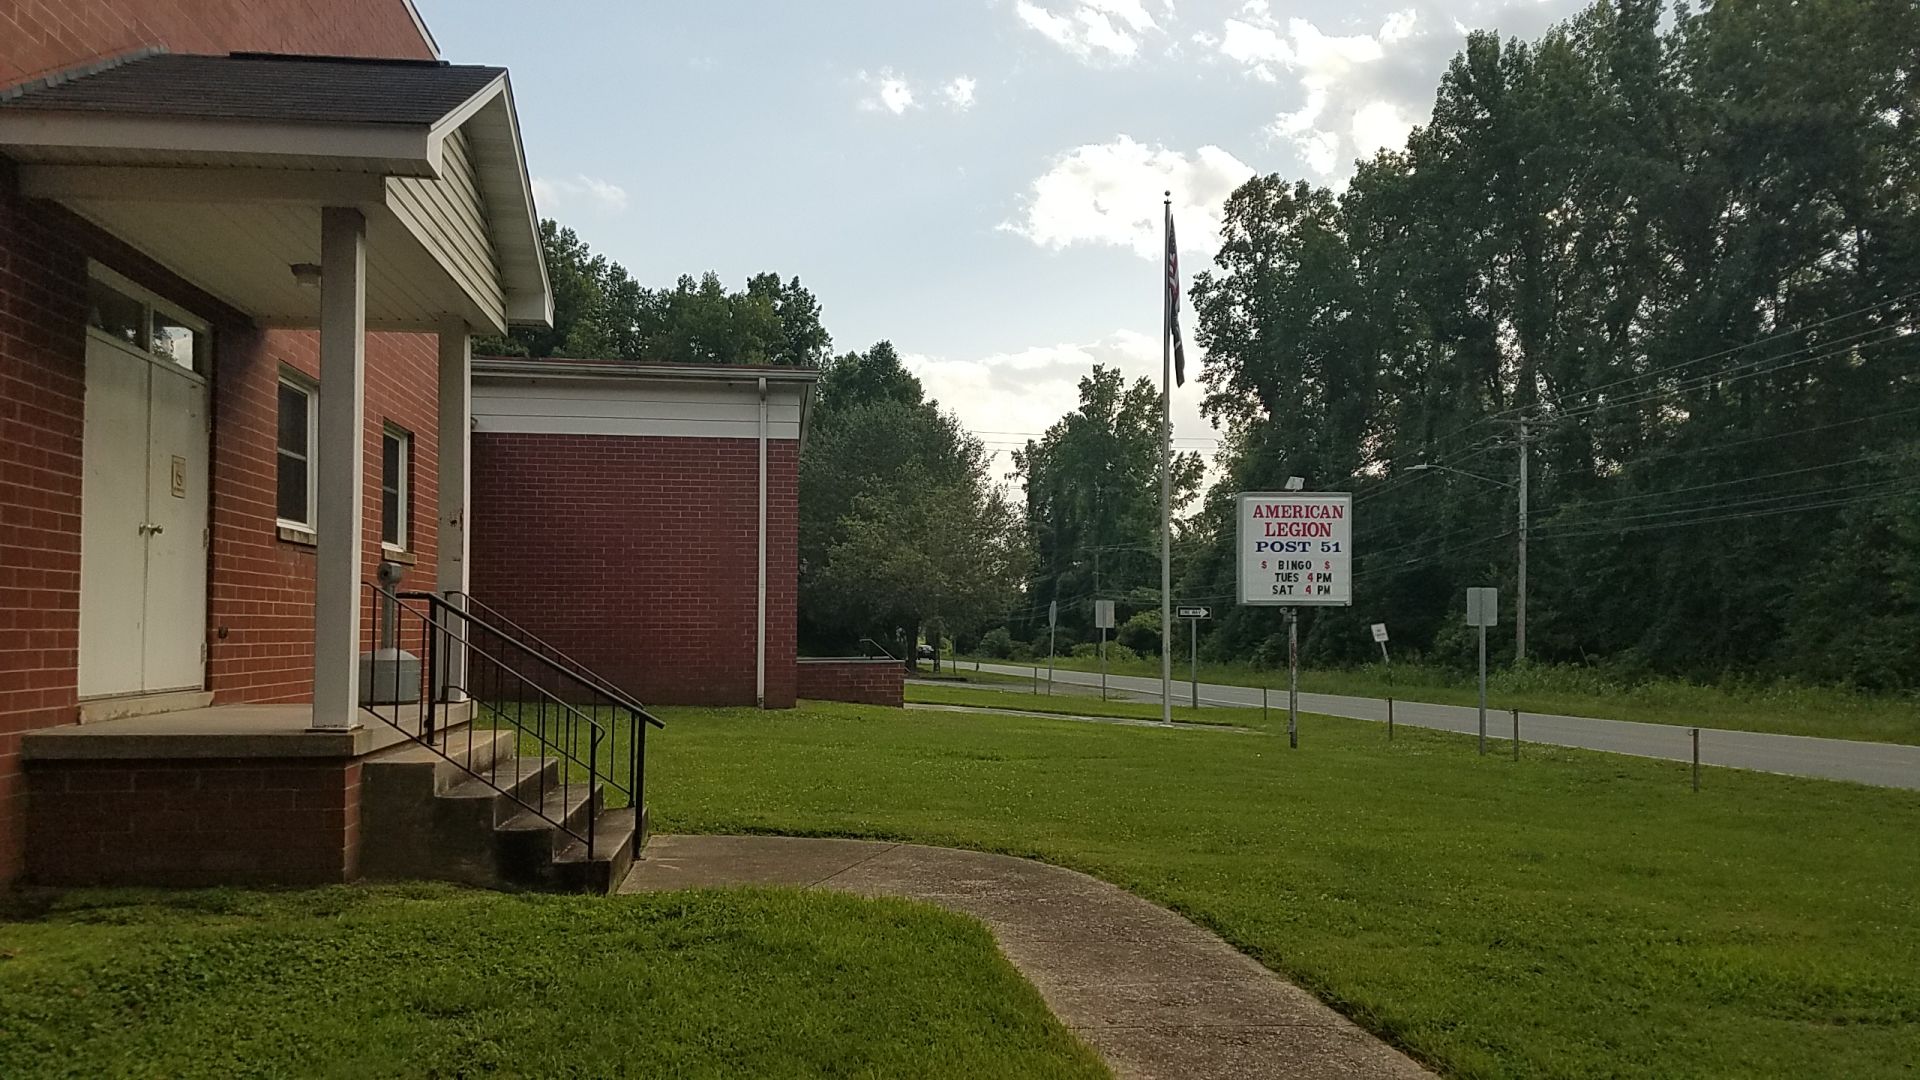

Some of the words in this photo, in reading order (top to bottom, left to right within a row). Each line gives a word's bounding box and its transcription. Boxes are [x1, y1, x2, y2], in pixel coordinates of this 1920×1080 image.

[1253, 504, 1345, 519] AMERICAN
[1264, 522, 1333, 537] LEGION
[1255, 541, 1312, 552] POST
[1320, 541, 1342, 552] 51
[1261, 560, 1268, 569] $
[1278, 560, 1312, 570] BINGO
[1324, 560, 1331, 570] $
[1274, 572, 1299, 582] TUES
[1307, 572, 1313, 582] 4
[1316, 572, 1332, 582] PM
[1272, 585, 1294, 595] SAT
[1305, 585, 1312, 595] 4
[1317, 585, 1331, 595] PM
